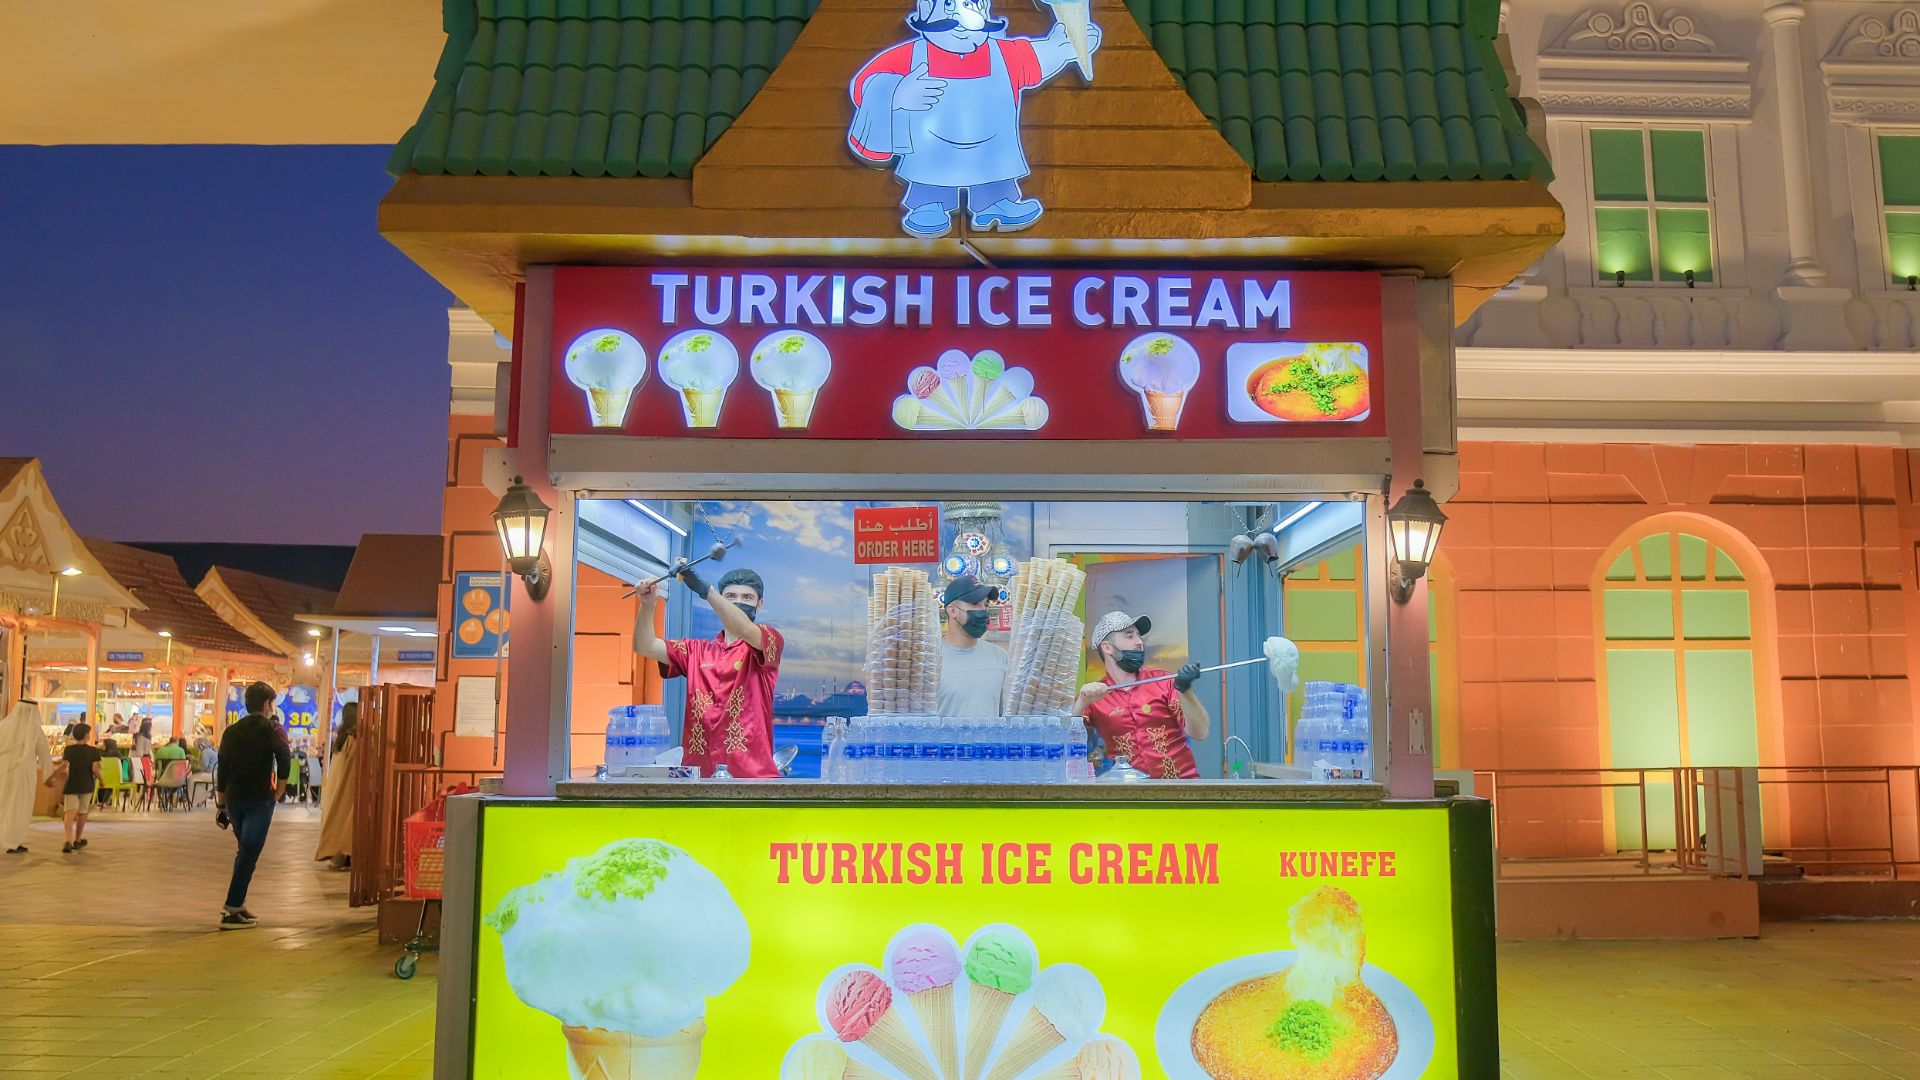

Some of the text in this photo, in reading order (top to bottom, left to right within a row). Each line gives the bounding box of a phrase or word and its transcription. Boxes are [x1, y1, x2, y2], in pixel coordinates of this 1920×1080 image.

[651, 274, 1292, 329] TURKISH ICE CREAM
[858, 512, 933, 535] أطلب هنا
[858, 540, 934, 558] ORDER HERE
[289, 711, 314, 726] 3D
[770, 842, 1220, 885] TURKISH ICE CREAM
[1279, 851, 1396, 877] KUNEFE
